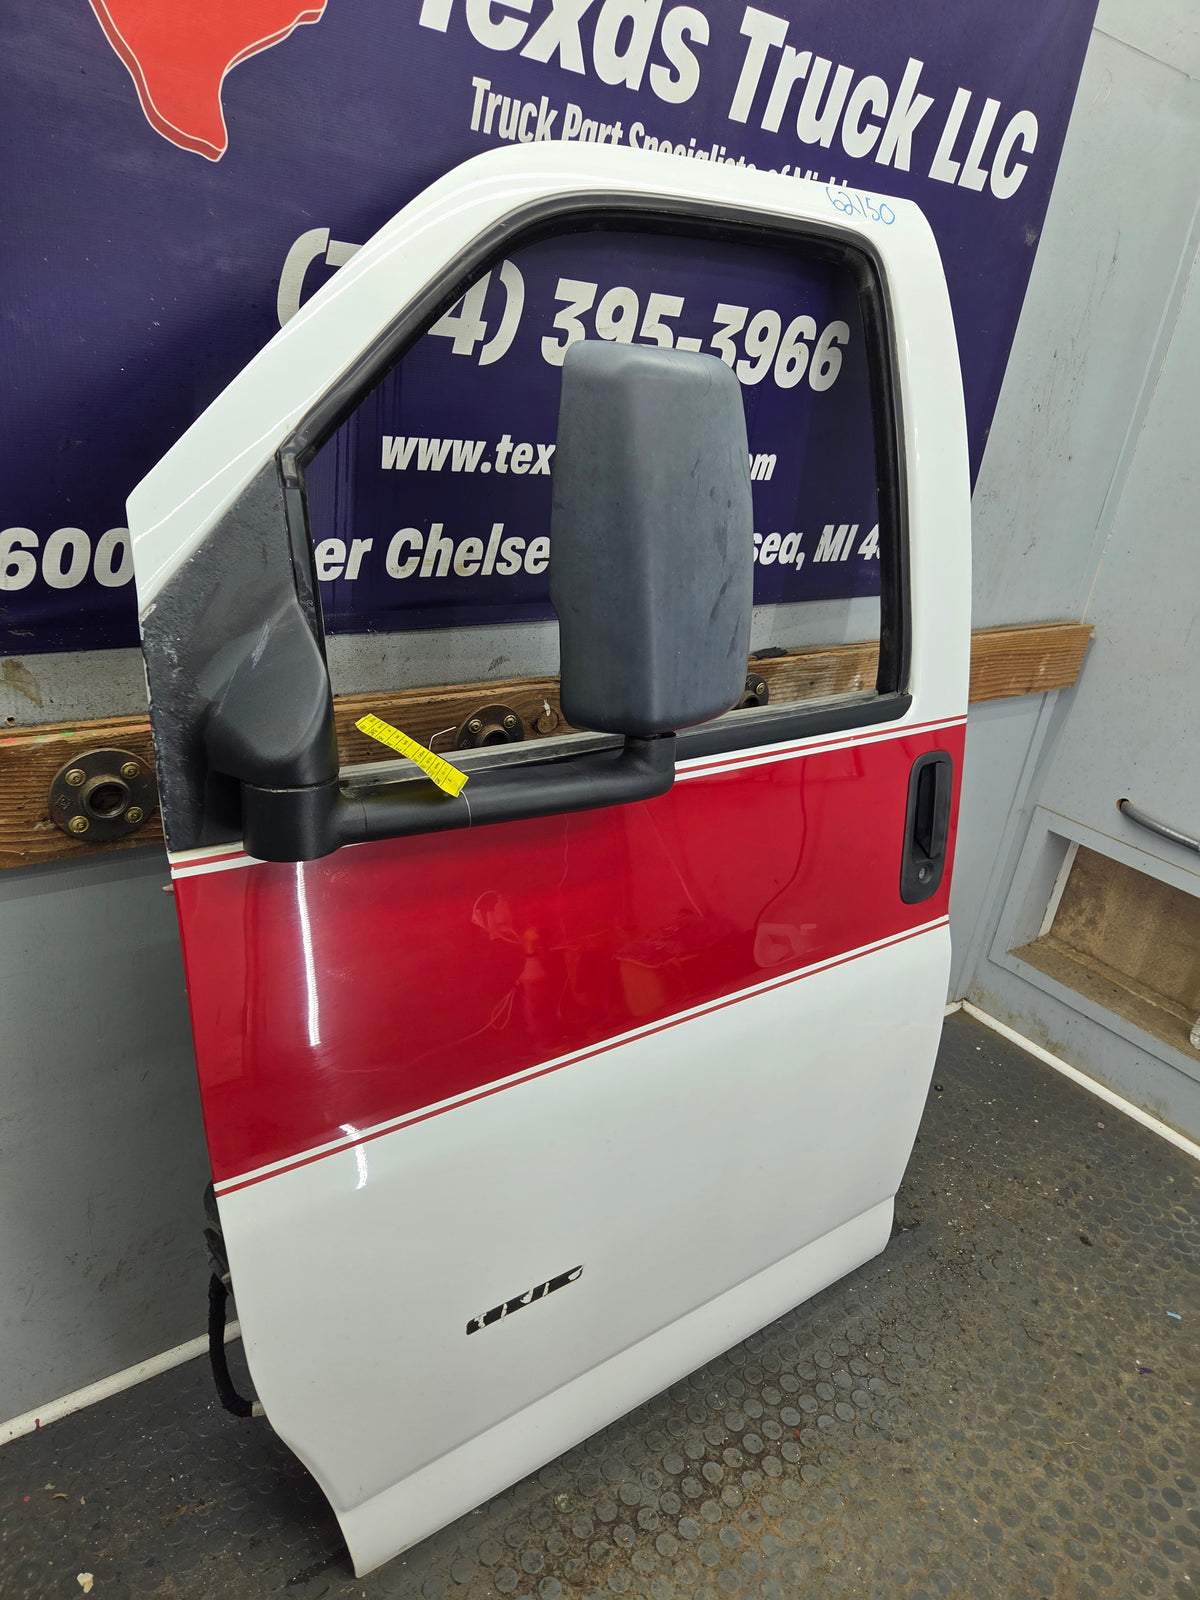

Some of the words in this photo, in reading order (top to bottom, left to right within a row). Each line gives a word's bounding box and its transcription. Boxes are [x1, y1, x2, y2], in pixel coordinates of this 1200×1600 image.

[419, 0, 710, 104] exas
[728, 6, 935, 171] Truck
[928, 86, 1039, 199] LLC
[470, 76, 559, 143] Truck
[825, 187, 896, 225] 62150
[541, 277, 850, 392] 395-3966
[0, 526, 135, 591] 600
[385, 523, 551, 579] Chelse
[812, 524, 860, 563] MI
[857, 523, 881, 561] 4
